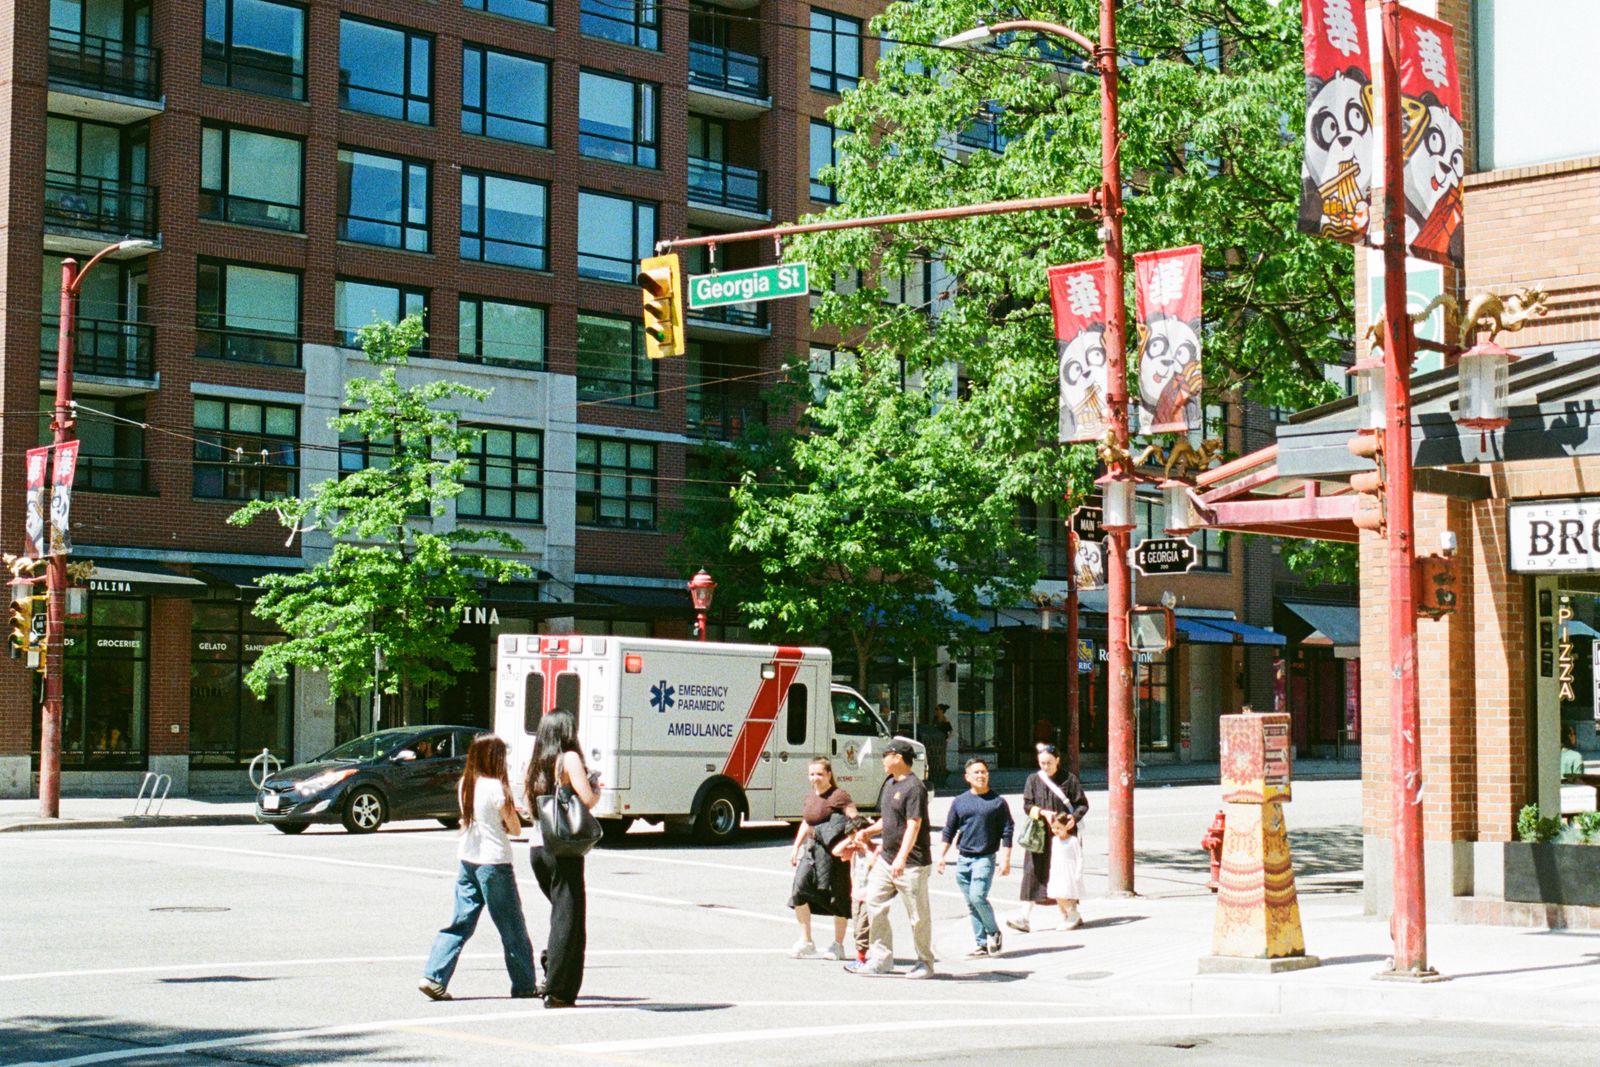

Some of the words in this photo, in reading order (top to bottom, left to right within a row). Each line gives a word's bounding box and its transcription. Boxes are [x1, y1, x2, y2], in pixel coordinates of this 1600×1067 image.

[1414, 26, 1449, 88] 華
[697, 272, 769, 300] Georgia
[778, 267, 800, 290] St
[1065, 272, 1102, 318] 華
[1527, 508, 1600, 519] stra
[1080, 518, 1095, 532] MAIN
[1139, 551, 1147, 565] E
[1147, 550, 1180, 564] GEORGIA
[1181, 549, 1190, 559] ST
[63, 638, 75, 646] DS
[97, 639, 140, 648] GROCERIES
[198, 643, 227, 651] GELATO
[1558, 607, 1574, 700] PIZZA
[1078, 662, 1092, 670] RBC
[678, 684, 729, 698] EMERGENCY
[677, 699, 725, 712] PARAMEDIC
[667, 722, 733, 738] AMBULANCE
